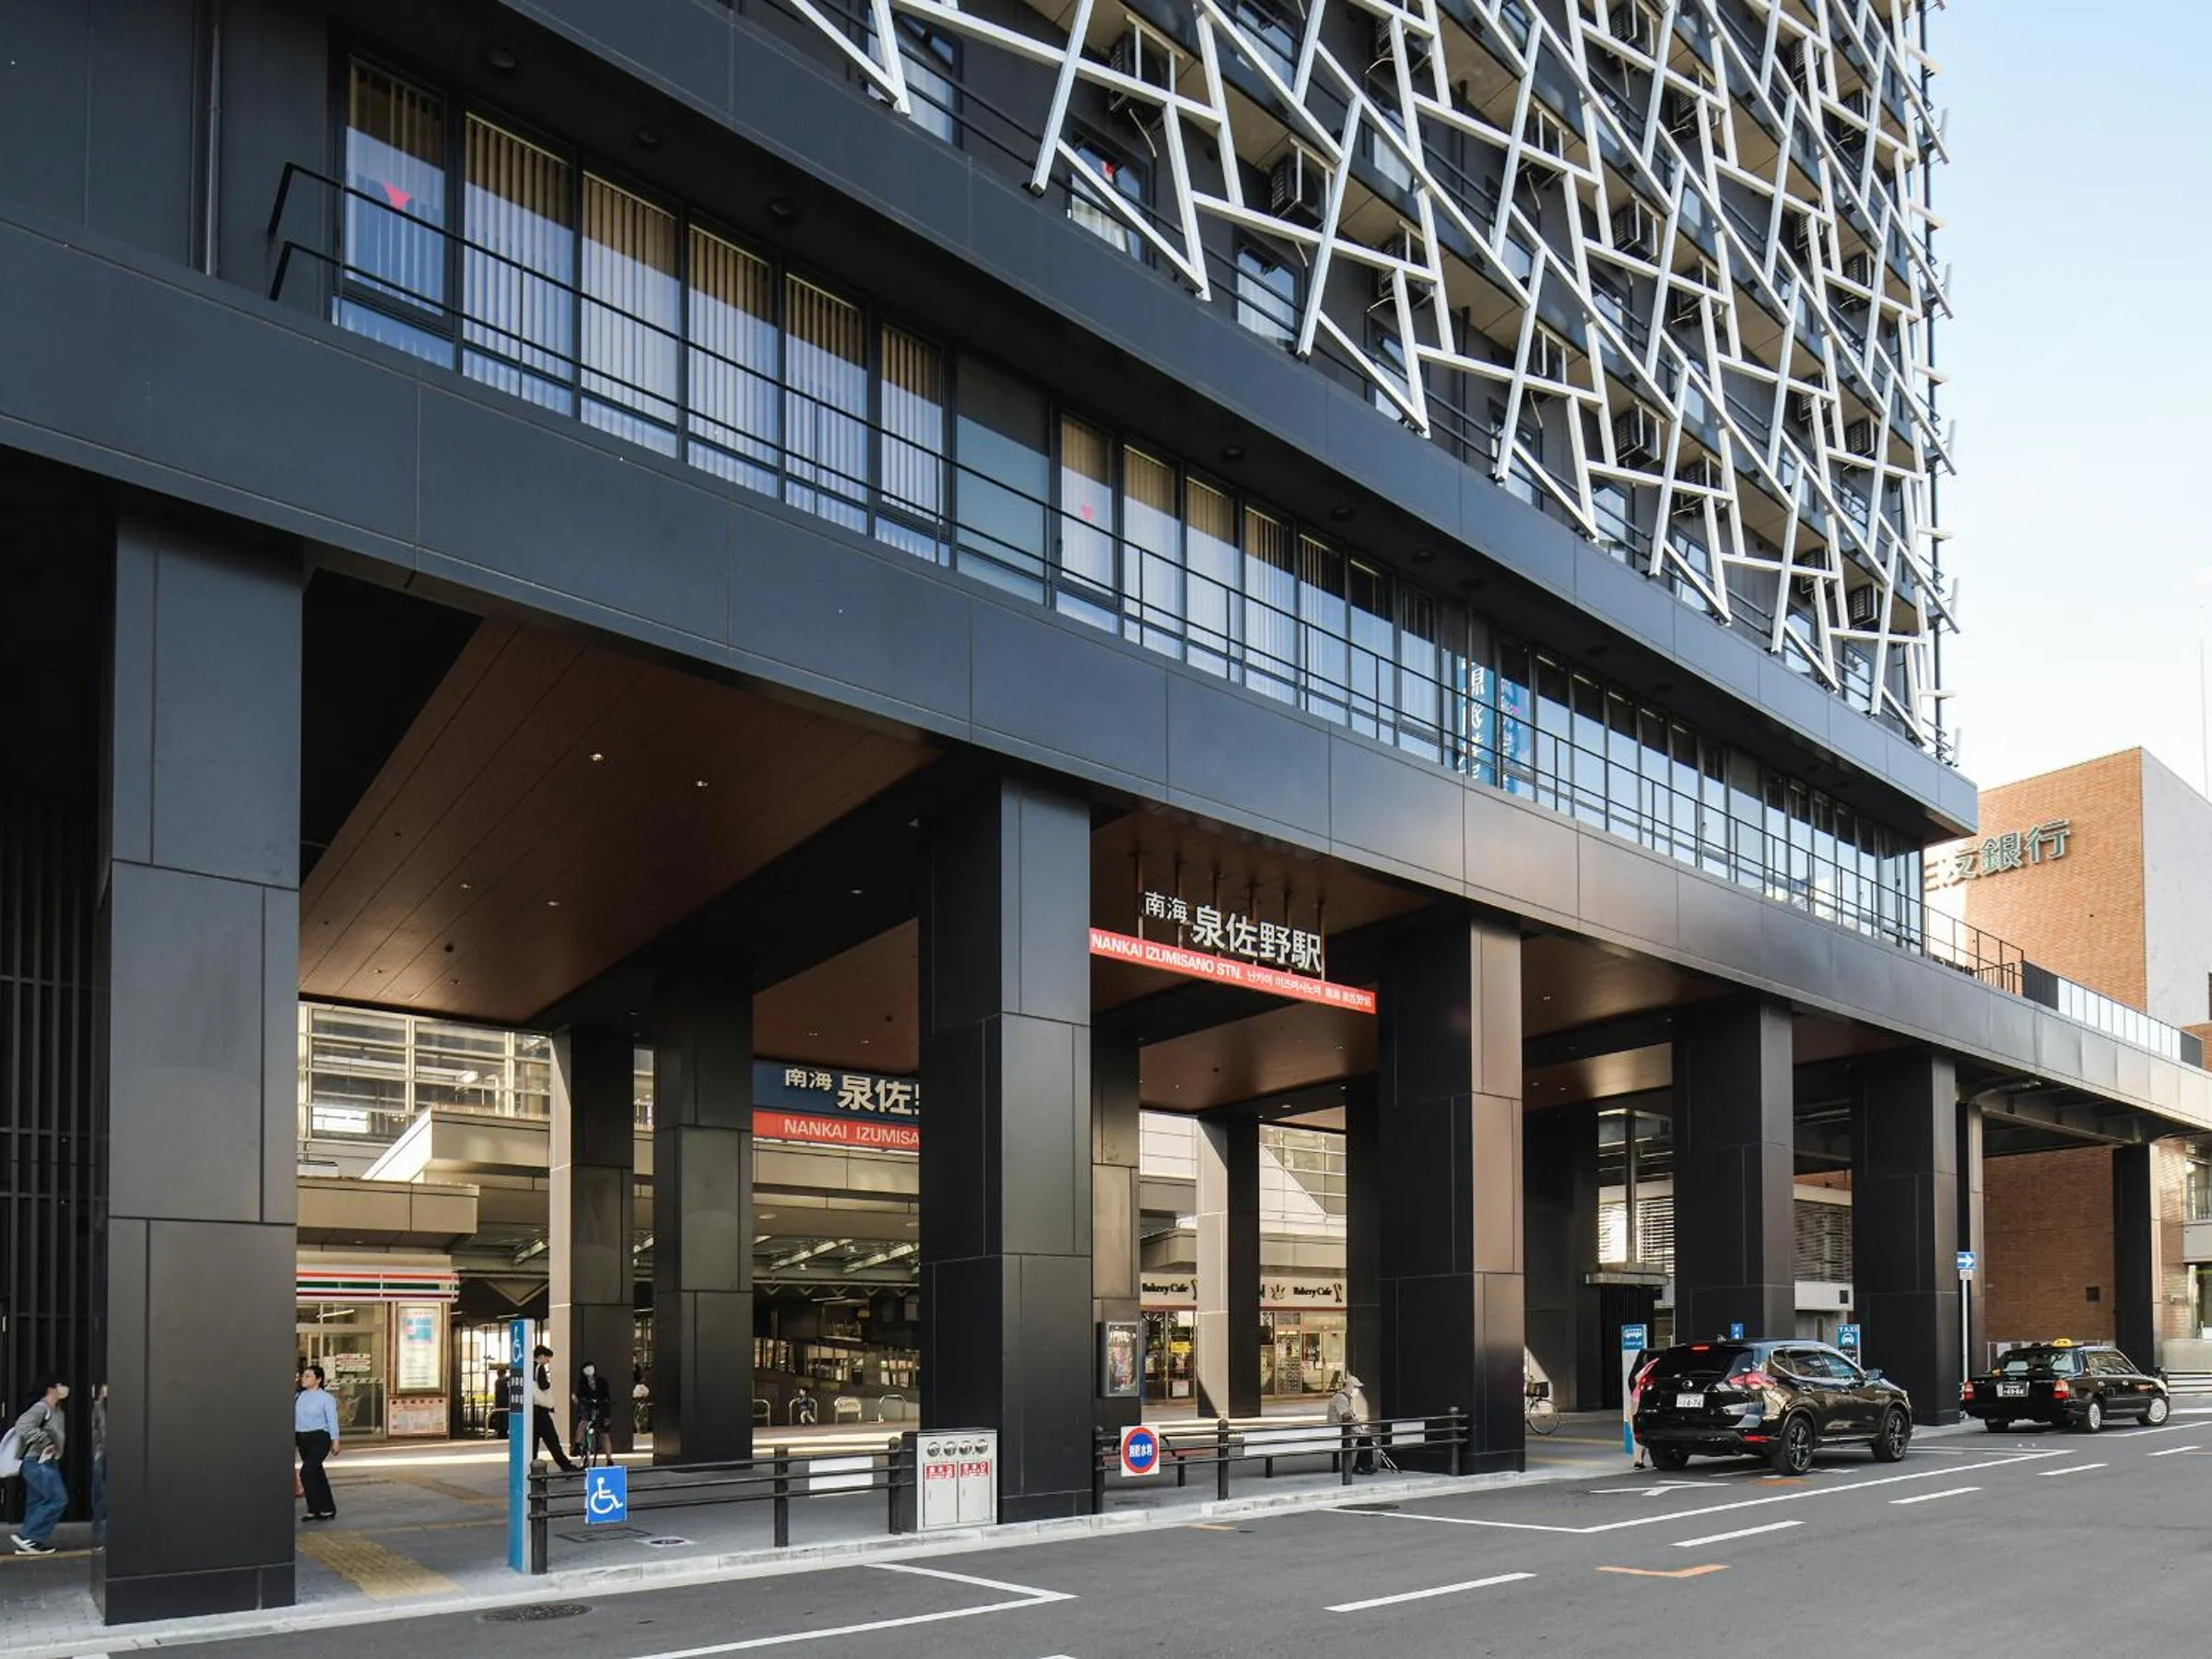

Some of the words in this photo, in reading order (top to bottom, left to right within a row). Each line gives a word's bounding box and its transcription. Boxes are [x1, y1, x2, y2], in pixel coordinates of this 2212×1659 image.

[1924, 818, 2070, 892] 友銀行
[1145, 891, 1188, 923] 南海
[1193, 905, 1321, 972] 泉佐野駅
[1091, 934, 1143, 959] NANKAI
[1146, 947, 1214, 973] IZUMISANO
[1217, 962, 1243, 980] STN.
[785, 1068, 832, 1090] 南海
[838, 1074, 919, 1116] 泉佐
[784, 1119, 847, 1139] NANKAI
[856, 1128, 919, 1144] IZUMISA
[1142, 1282, 1170, 1295] Bakery
